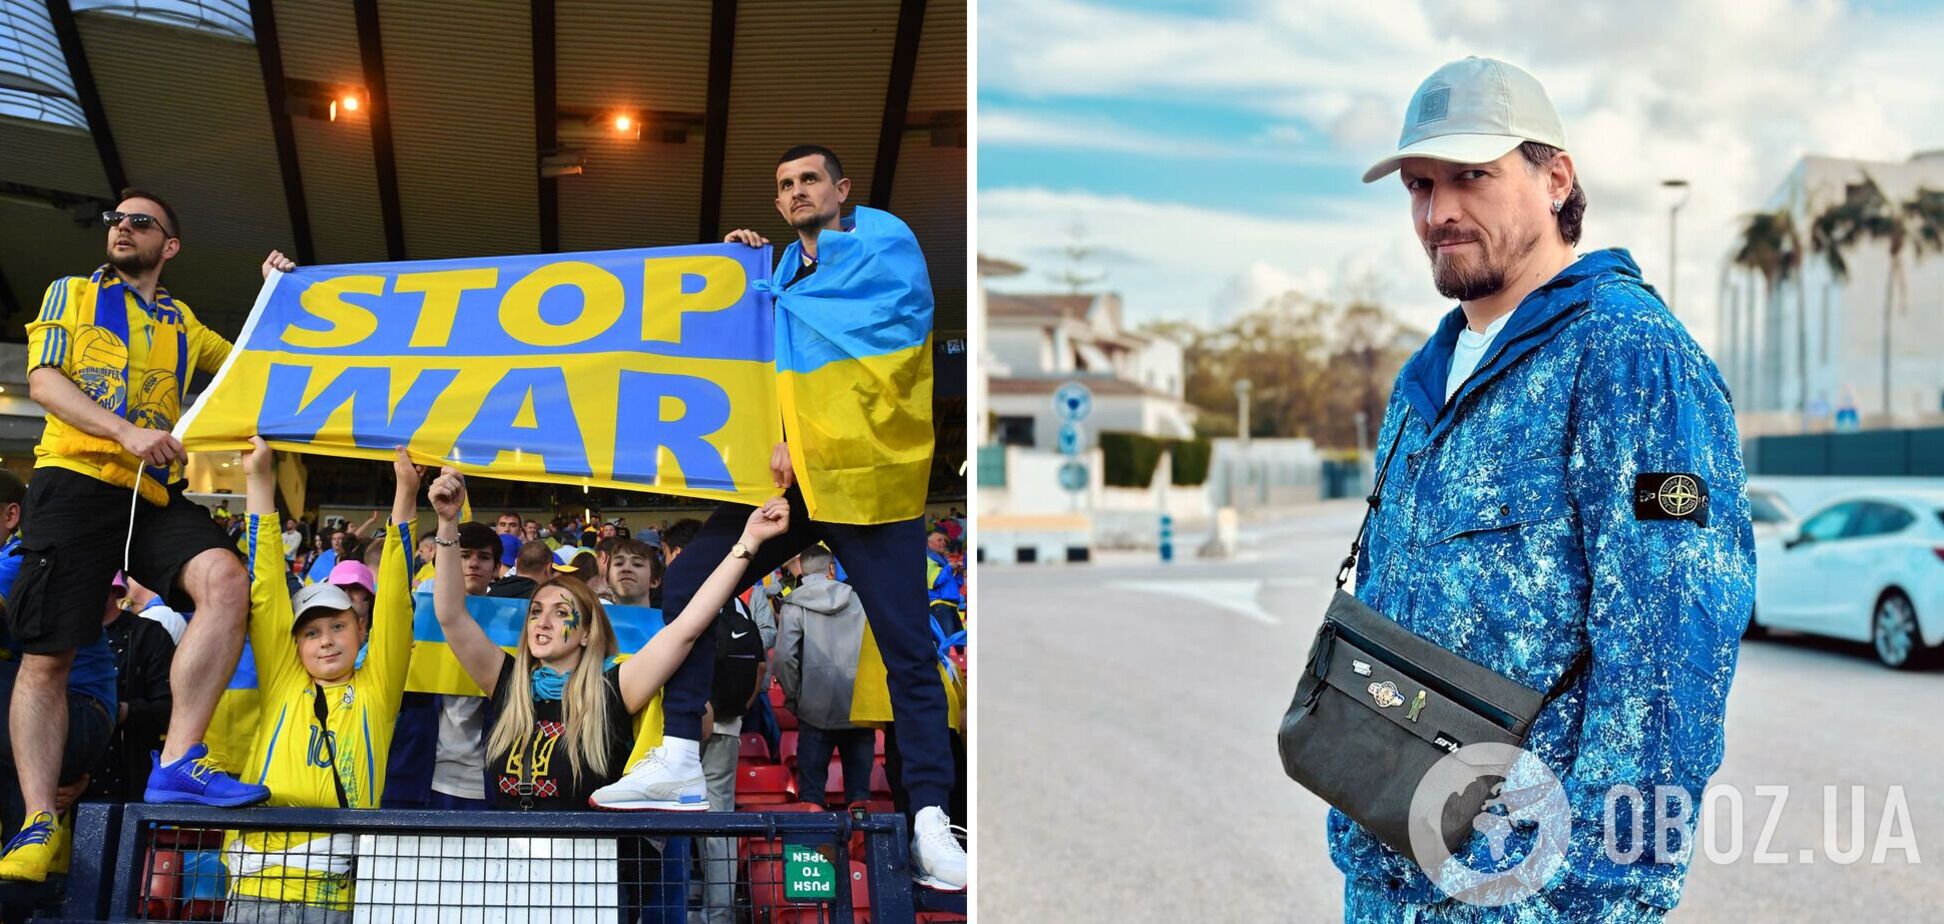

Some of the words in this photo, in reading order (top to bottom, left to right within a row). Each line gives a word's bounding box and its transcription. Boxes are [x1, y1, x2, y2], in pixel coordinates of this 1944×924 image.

[280, 255, 747, 348] STOP
[256, 363, 737, 492] WAR
[307, 724, 337, 768] 10
[793, 881, 830, 891] PUSH
[802, 867, 820, 877] TO
